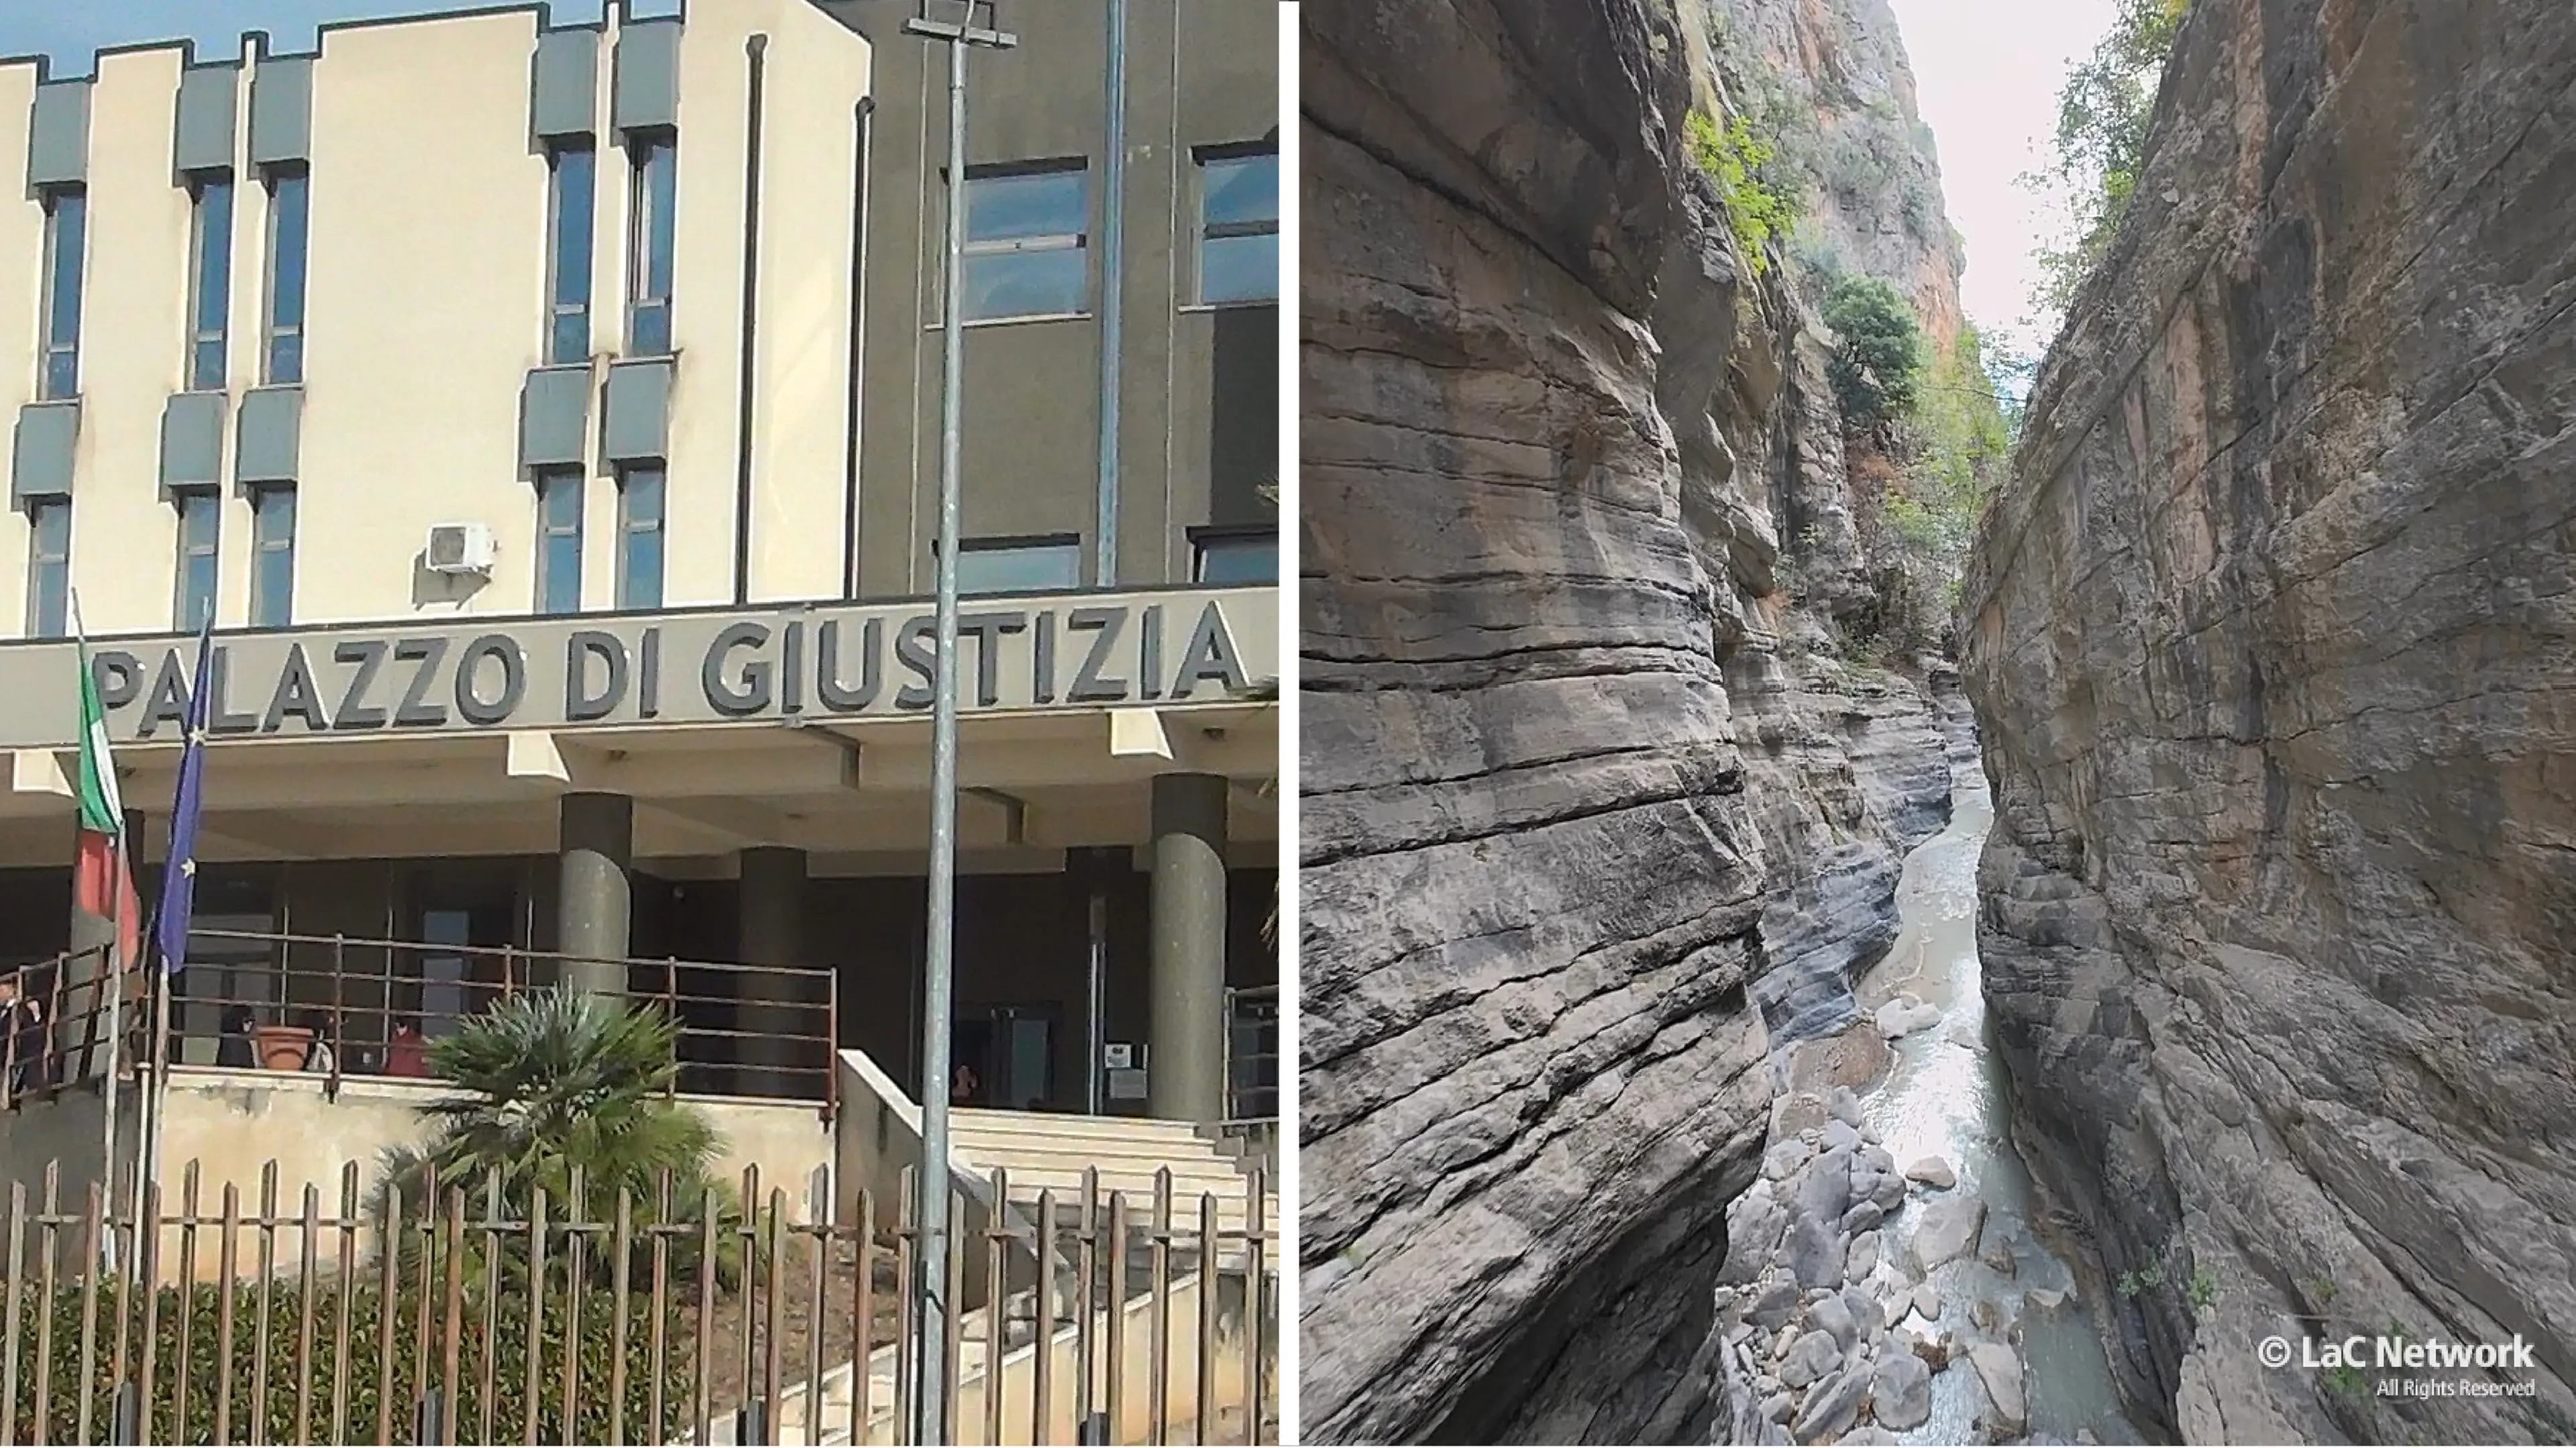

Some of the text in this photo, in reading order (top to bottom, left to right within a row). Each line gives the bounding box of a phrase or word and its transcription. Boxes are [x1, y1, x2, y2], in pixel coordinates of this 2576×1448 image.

[91, 602, 1250, 737] PALAZZO DI GIUSTIZIA
